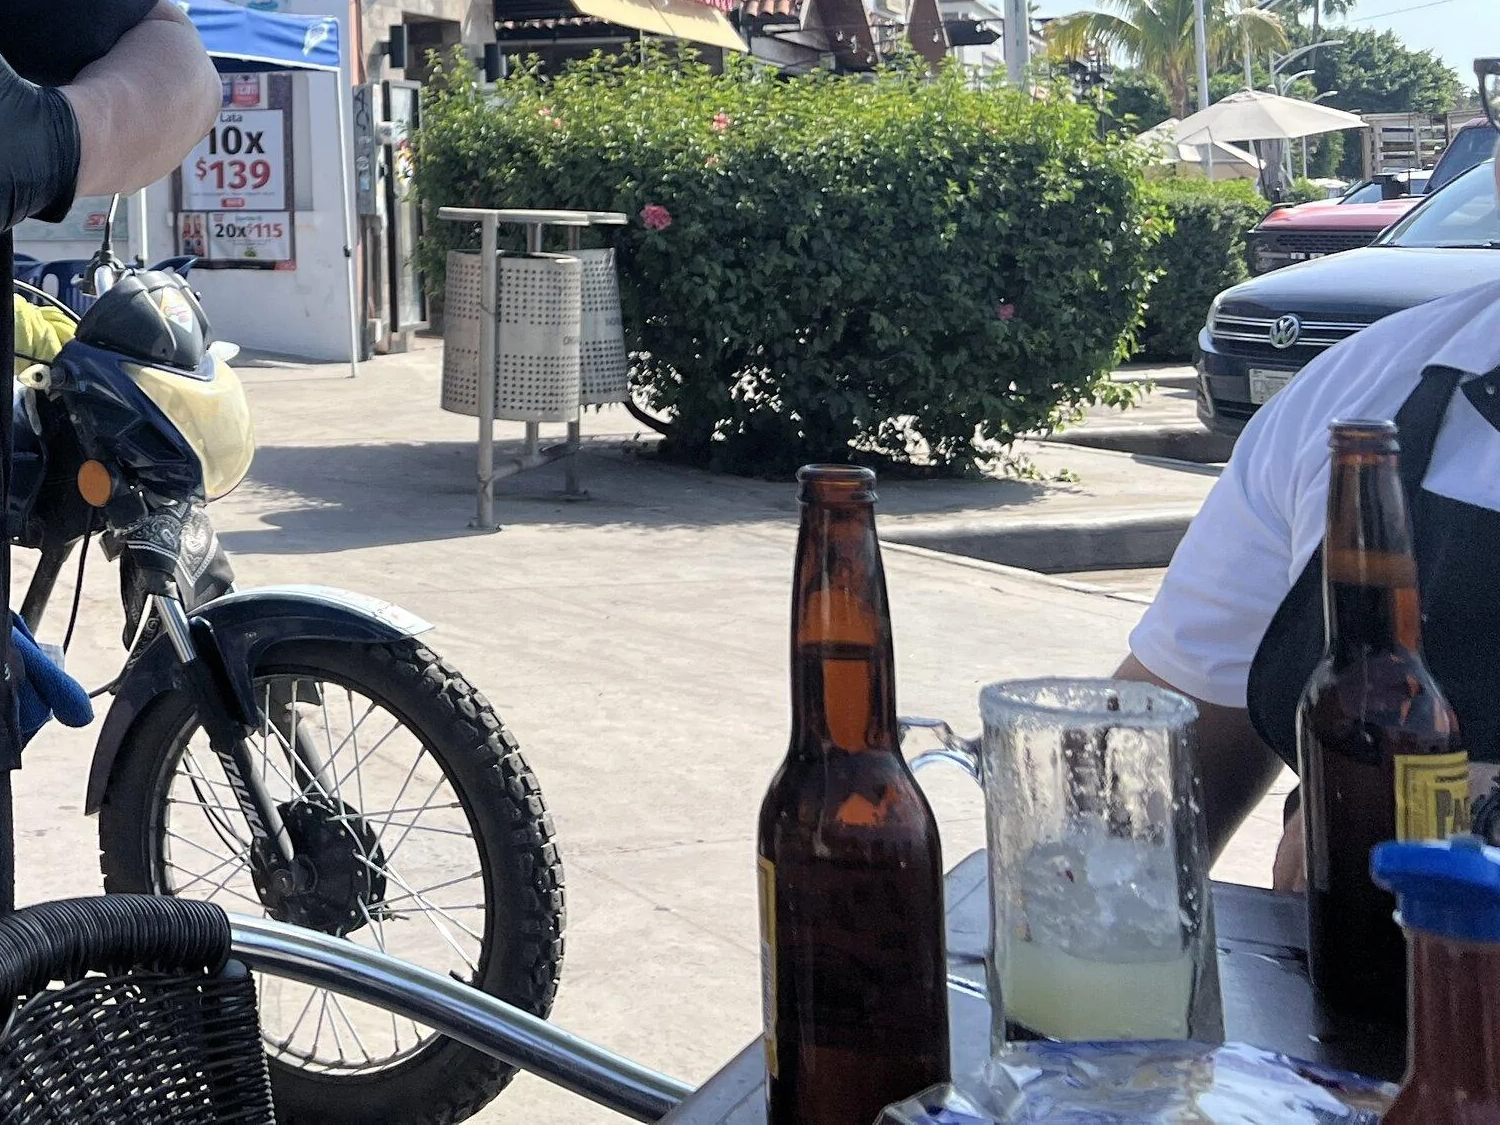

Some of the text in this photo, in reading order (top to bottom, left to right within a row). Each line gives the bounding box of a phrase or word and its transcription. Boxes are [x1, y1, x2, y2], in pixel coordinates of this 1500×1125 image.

[219, 112, 243, 123] Lata
[209, 125, 265, 155] 10x
[196, 157, 271, 190] $139
[214, 222, 283, 238] 20x $115
